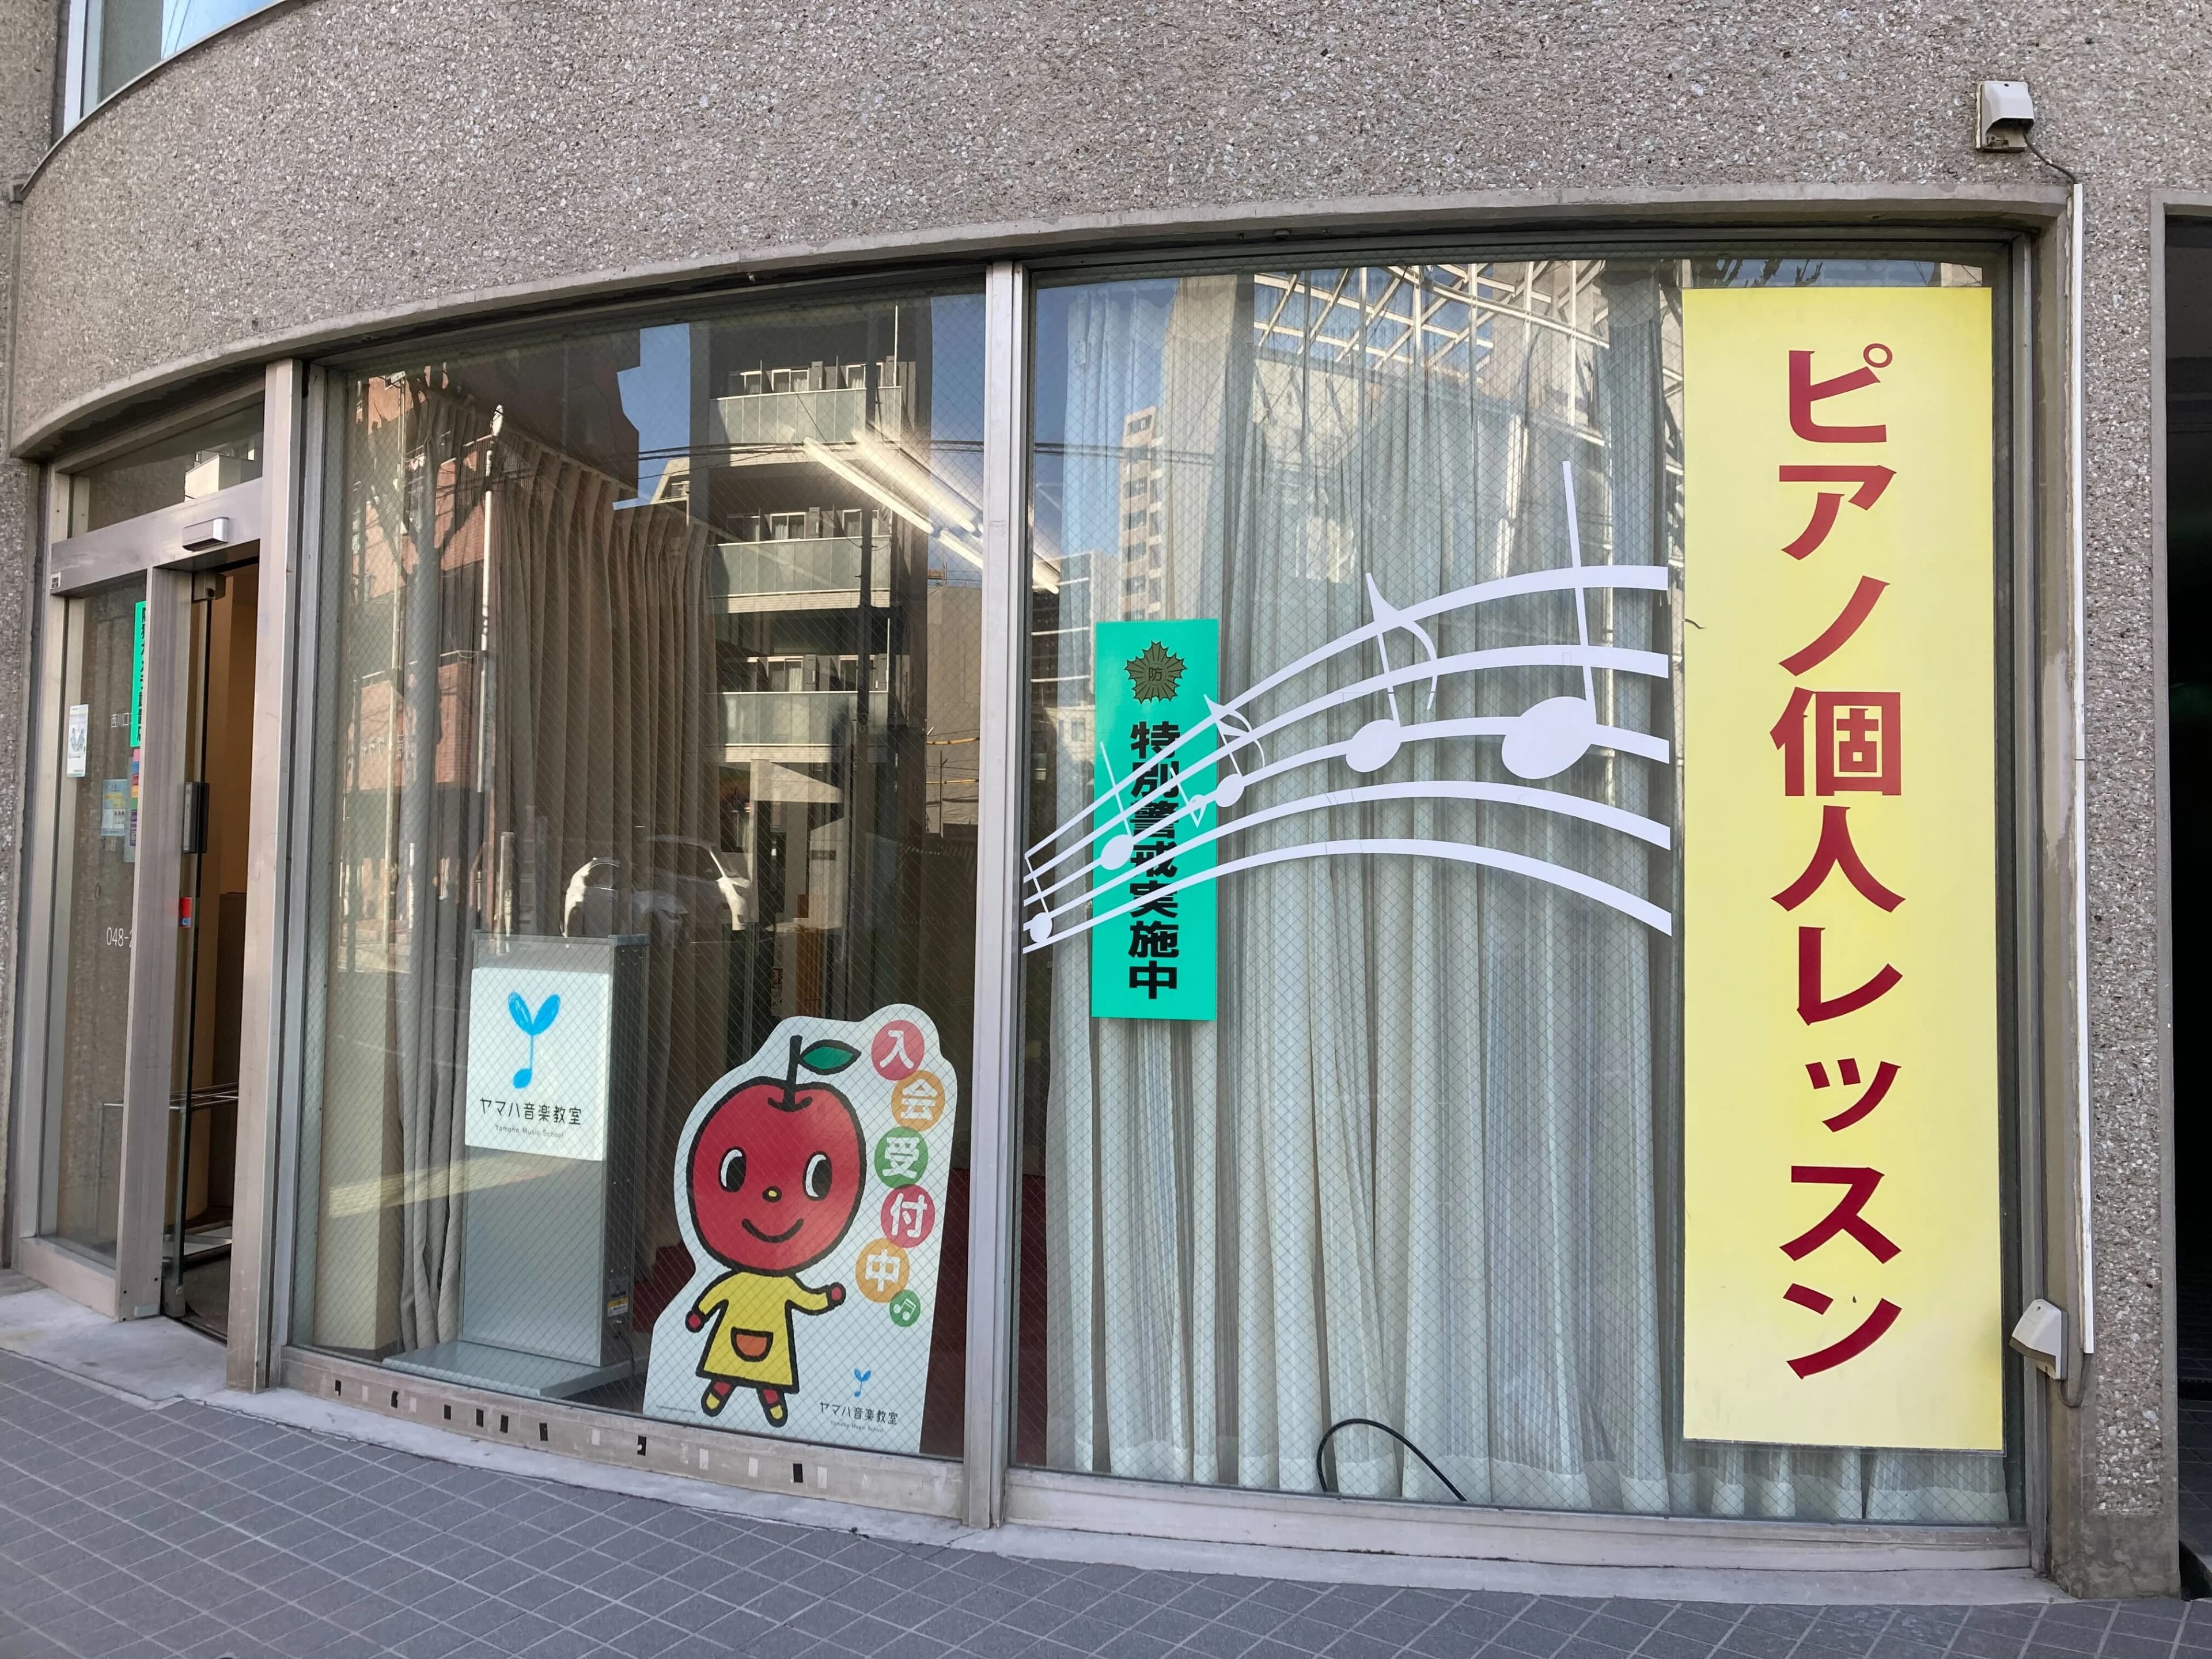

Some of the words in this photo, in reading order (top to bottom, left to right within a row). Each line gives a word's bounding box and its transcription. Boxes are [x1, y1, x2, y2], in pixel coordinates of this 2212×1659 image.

[1149, 667, 1163, 681] 防
[111, 713, 132, 728] 西川口
[1128, 721, 1181, 1000] 特別警戒実施中
[1770, 343, 1906, 1380] ピアノ個人レッスン
[480, 1097, 582, 1125] ヤマハ音楽教室
[495, 1124, 519, 1133] Yamaha
[522, 1127, 540, 1137] Music
[543, 1129, 564, 1139] School
[865, 1029, 938, 1292] 入会受付中
[820, 1401, 898, 1425] ヤマハ音楽教室
